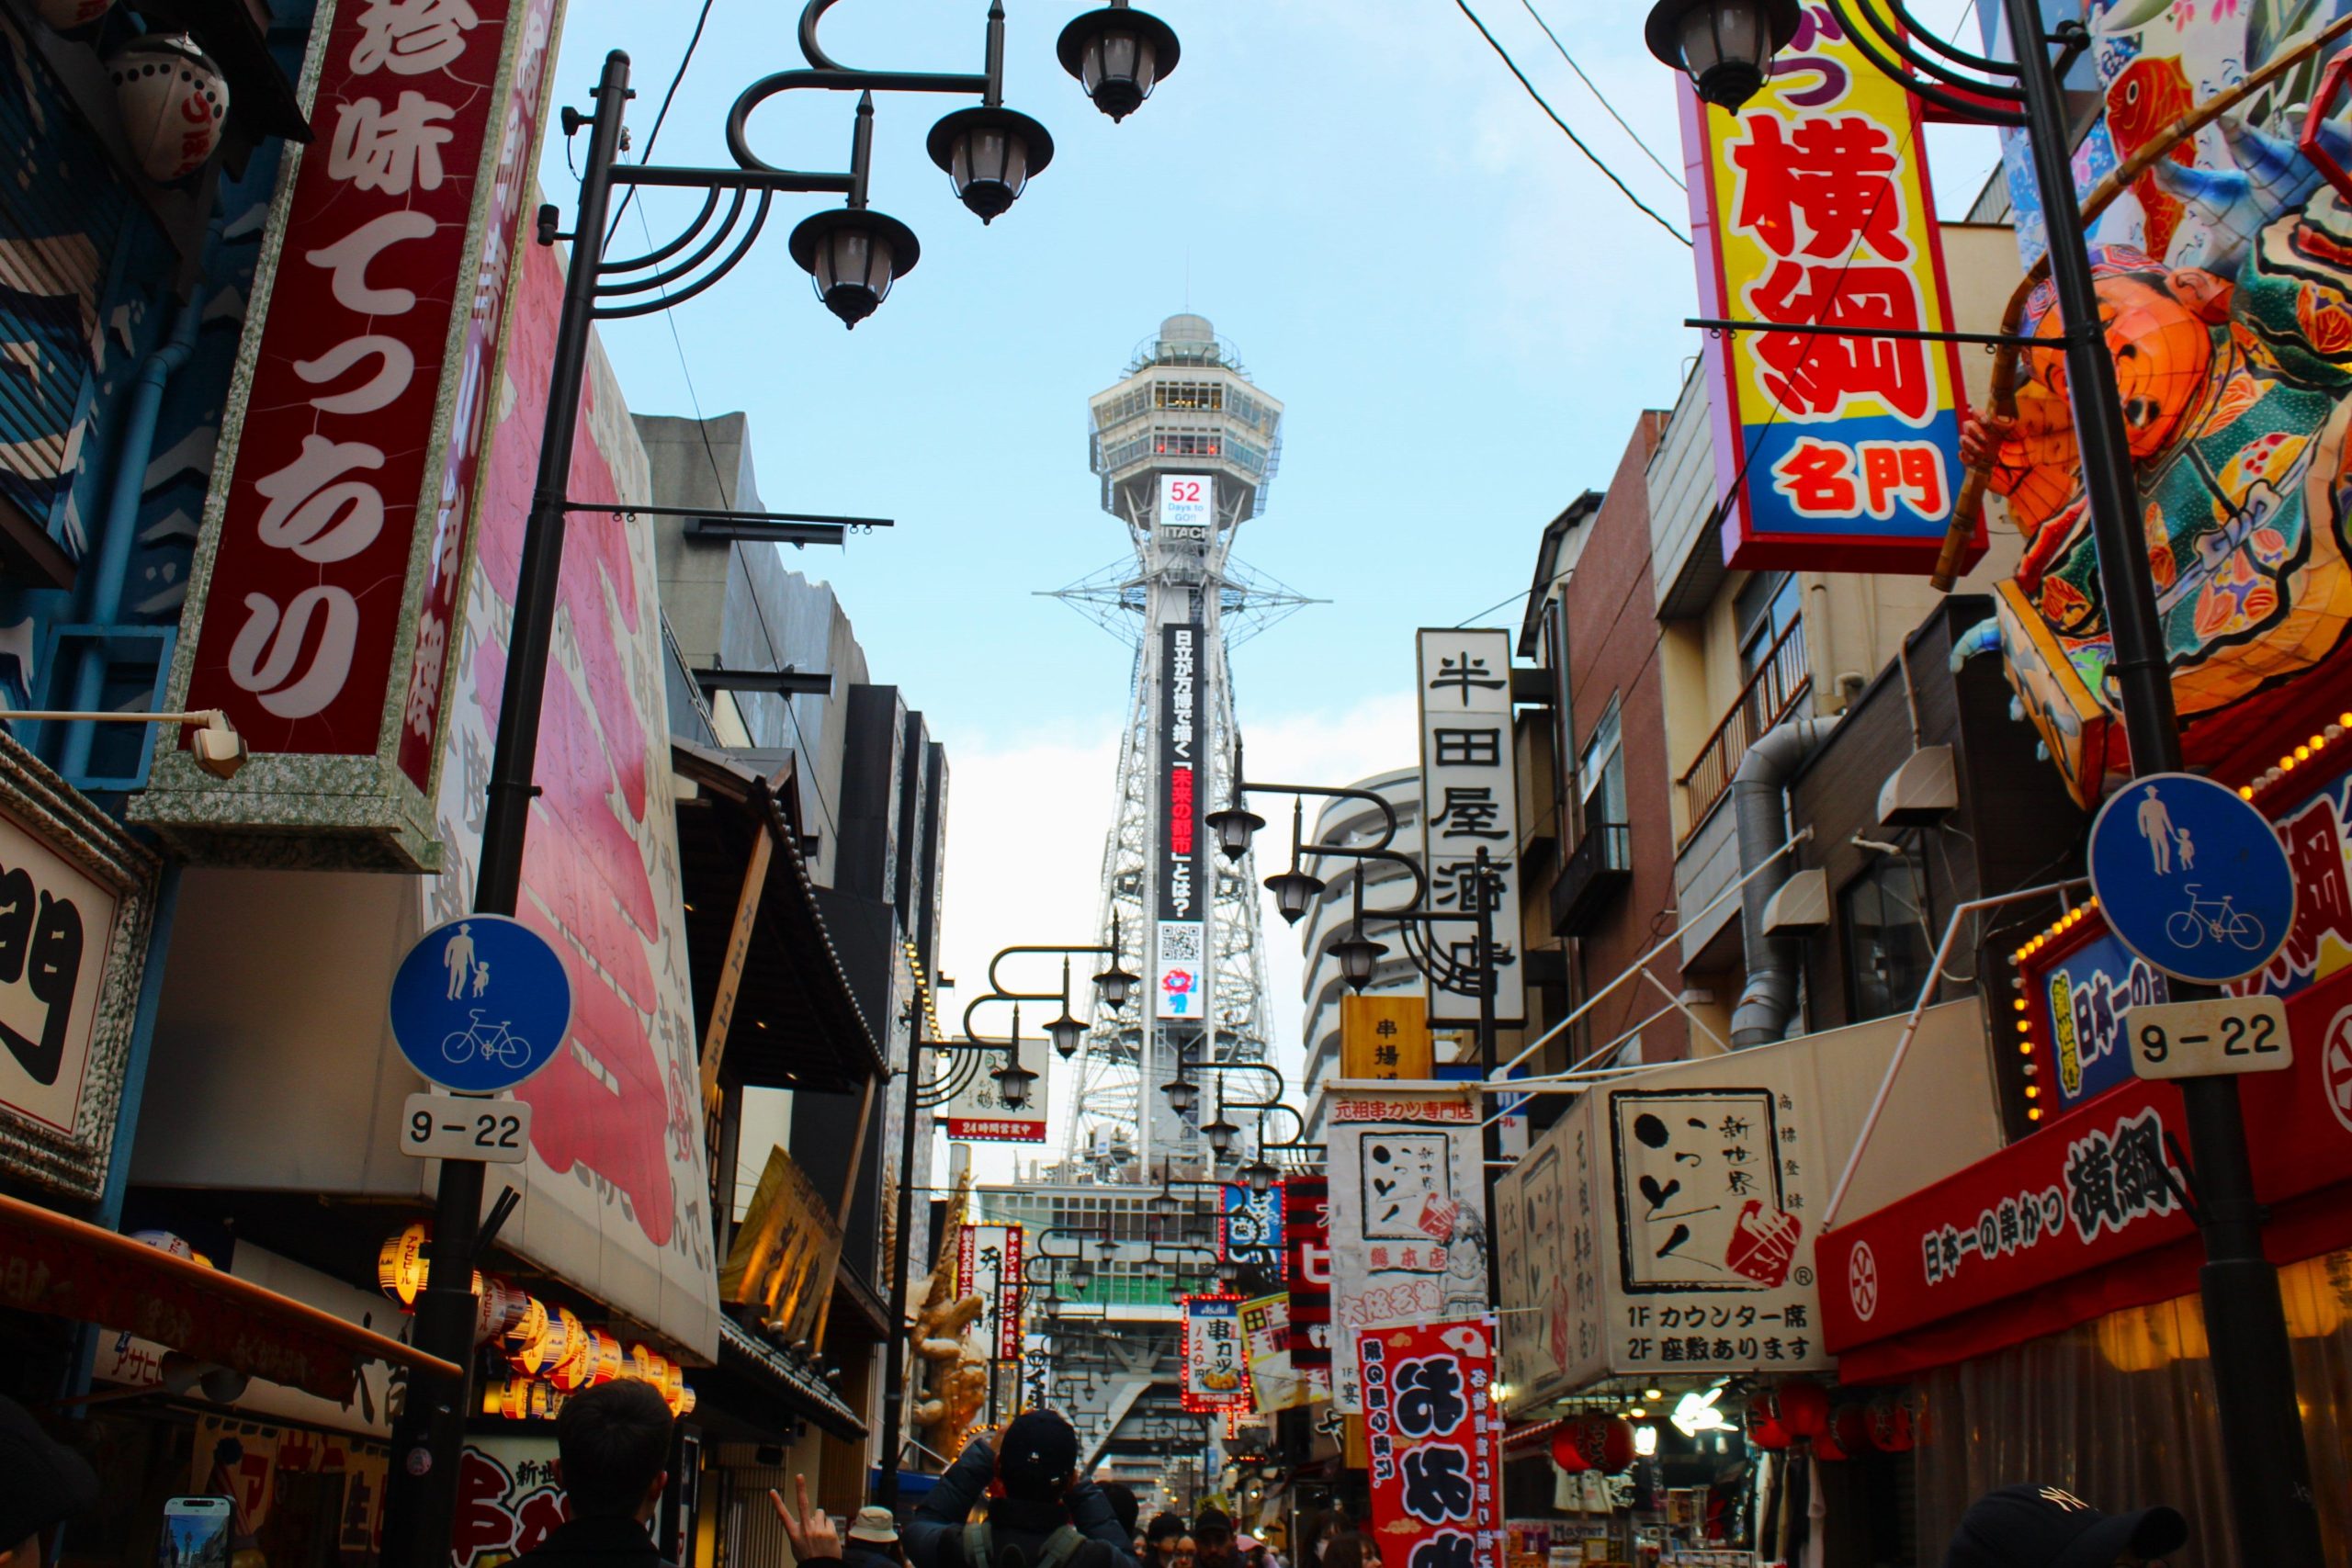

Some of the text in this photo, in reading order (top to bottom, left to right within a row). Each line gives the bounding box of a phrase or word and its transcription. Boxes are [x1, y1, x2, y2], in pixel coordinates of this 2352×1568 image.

[1733, 114, 1928, 421] 横綱
[1171, 481, 1201, 502] 52
[1780, 445, 1942, 513] 名門
[1168, 502, 1204, 513] Days to
[1335, 1100, 1475, 1121] 元祖串カツ専門店
[962, 1122, 1031, 1135] 24時間営業中
[1719, 1114, 1760, 1196] 新世界
[1778, 1093, 1804, 1211] 商標登録
[2064, 1105, 2179, 1244] 横綱
[1922, 1184, 2065, 1286] 日本一の串かつ
[1201, 1304, 1228, 1314] Asahi
[1659, 1303, 1808, 1329] カウンター席
[1207, 1319, 1233, 1374] 串カツ
[1660, 1337, 1810, 1361] 座敷あります
[516, 1459, 555, 1487] 新世
